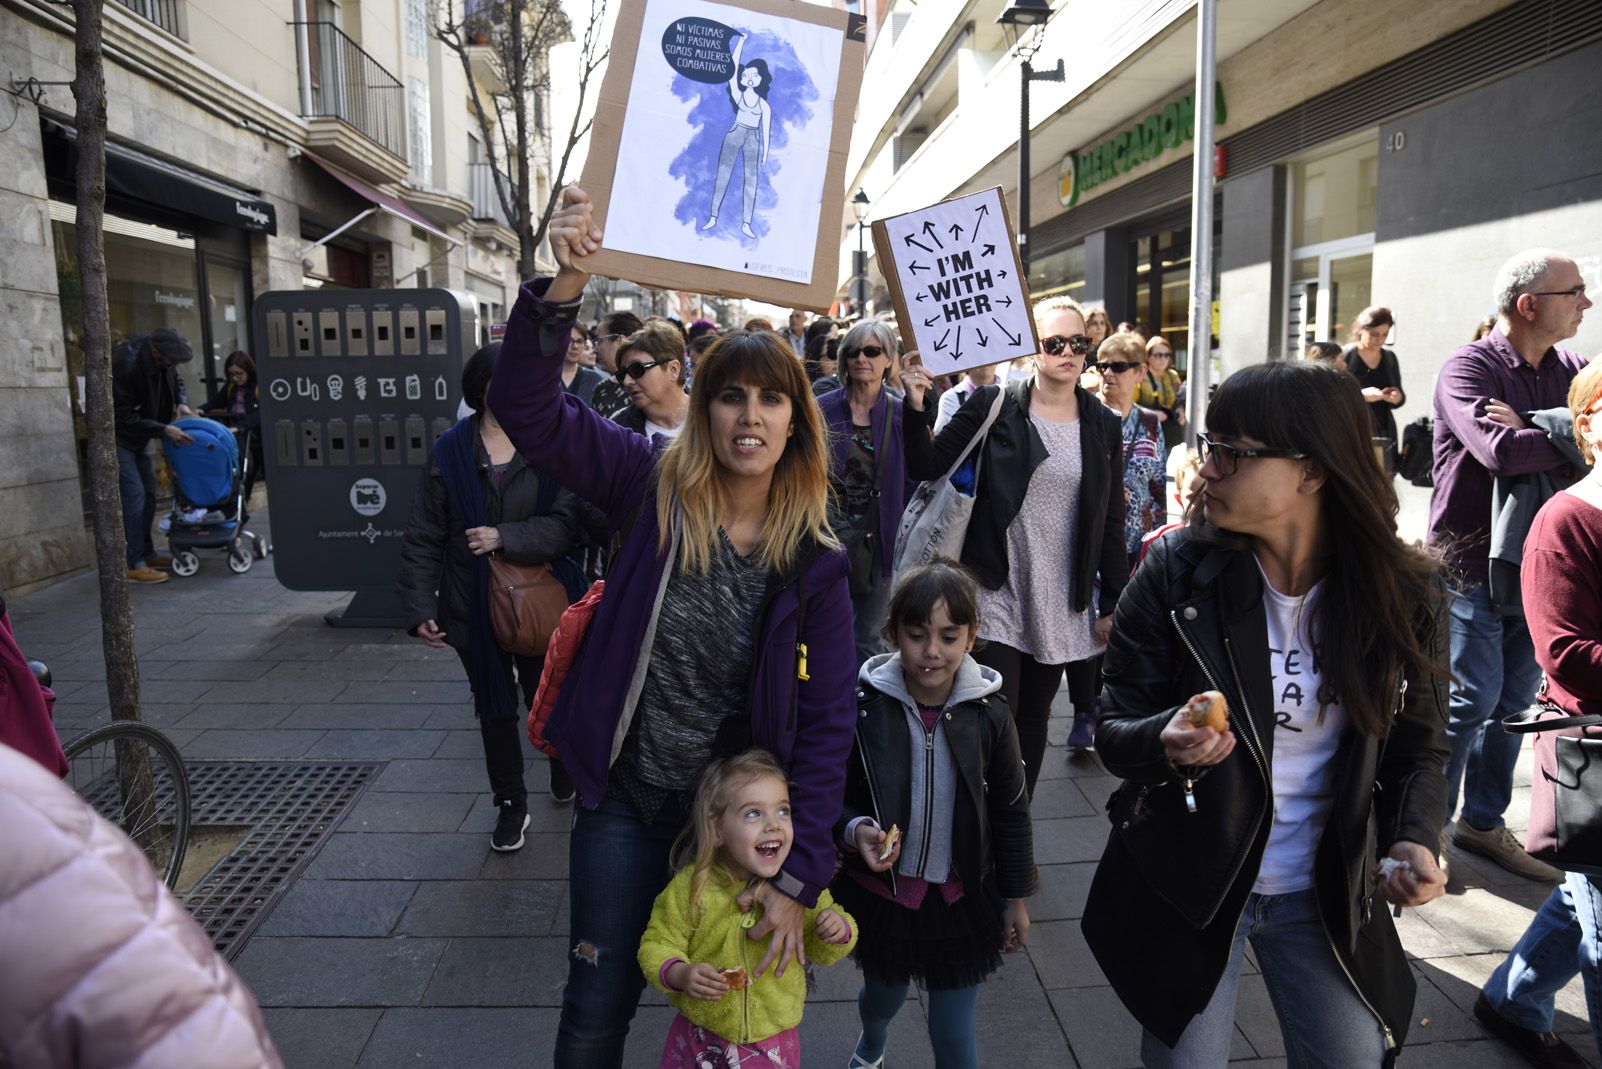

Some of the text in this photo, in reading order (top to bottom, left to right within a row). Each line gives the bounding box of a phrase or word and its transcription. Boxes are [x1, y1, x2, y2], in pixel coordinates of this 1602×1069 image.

[676, 23, 724, 39] NI VÍCTIMAS
[676, 34, 722, 50] NI PASIVAS
[664, 44, 731, 63] SOMOS MUJERES
[676, 57, 727, 74] COMBATIVAS
[1385, 131, 1406, 154] 40
[936, 250, 974, 277] I'M
[928, 268, 994, 302] WITH
[942, 294, 993, 323] HER
